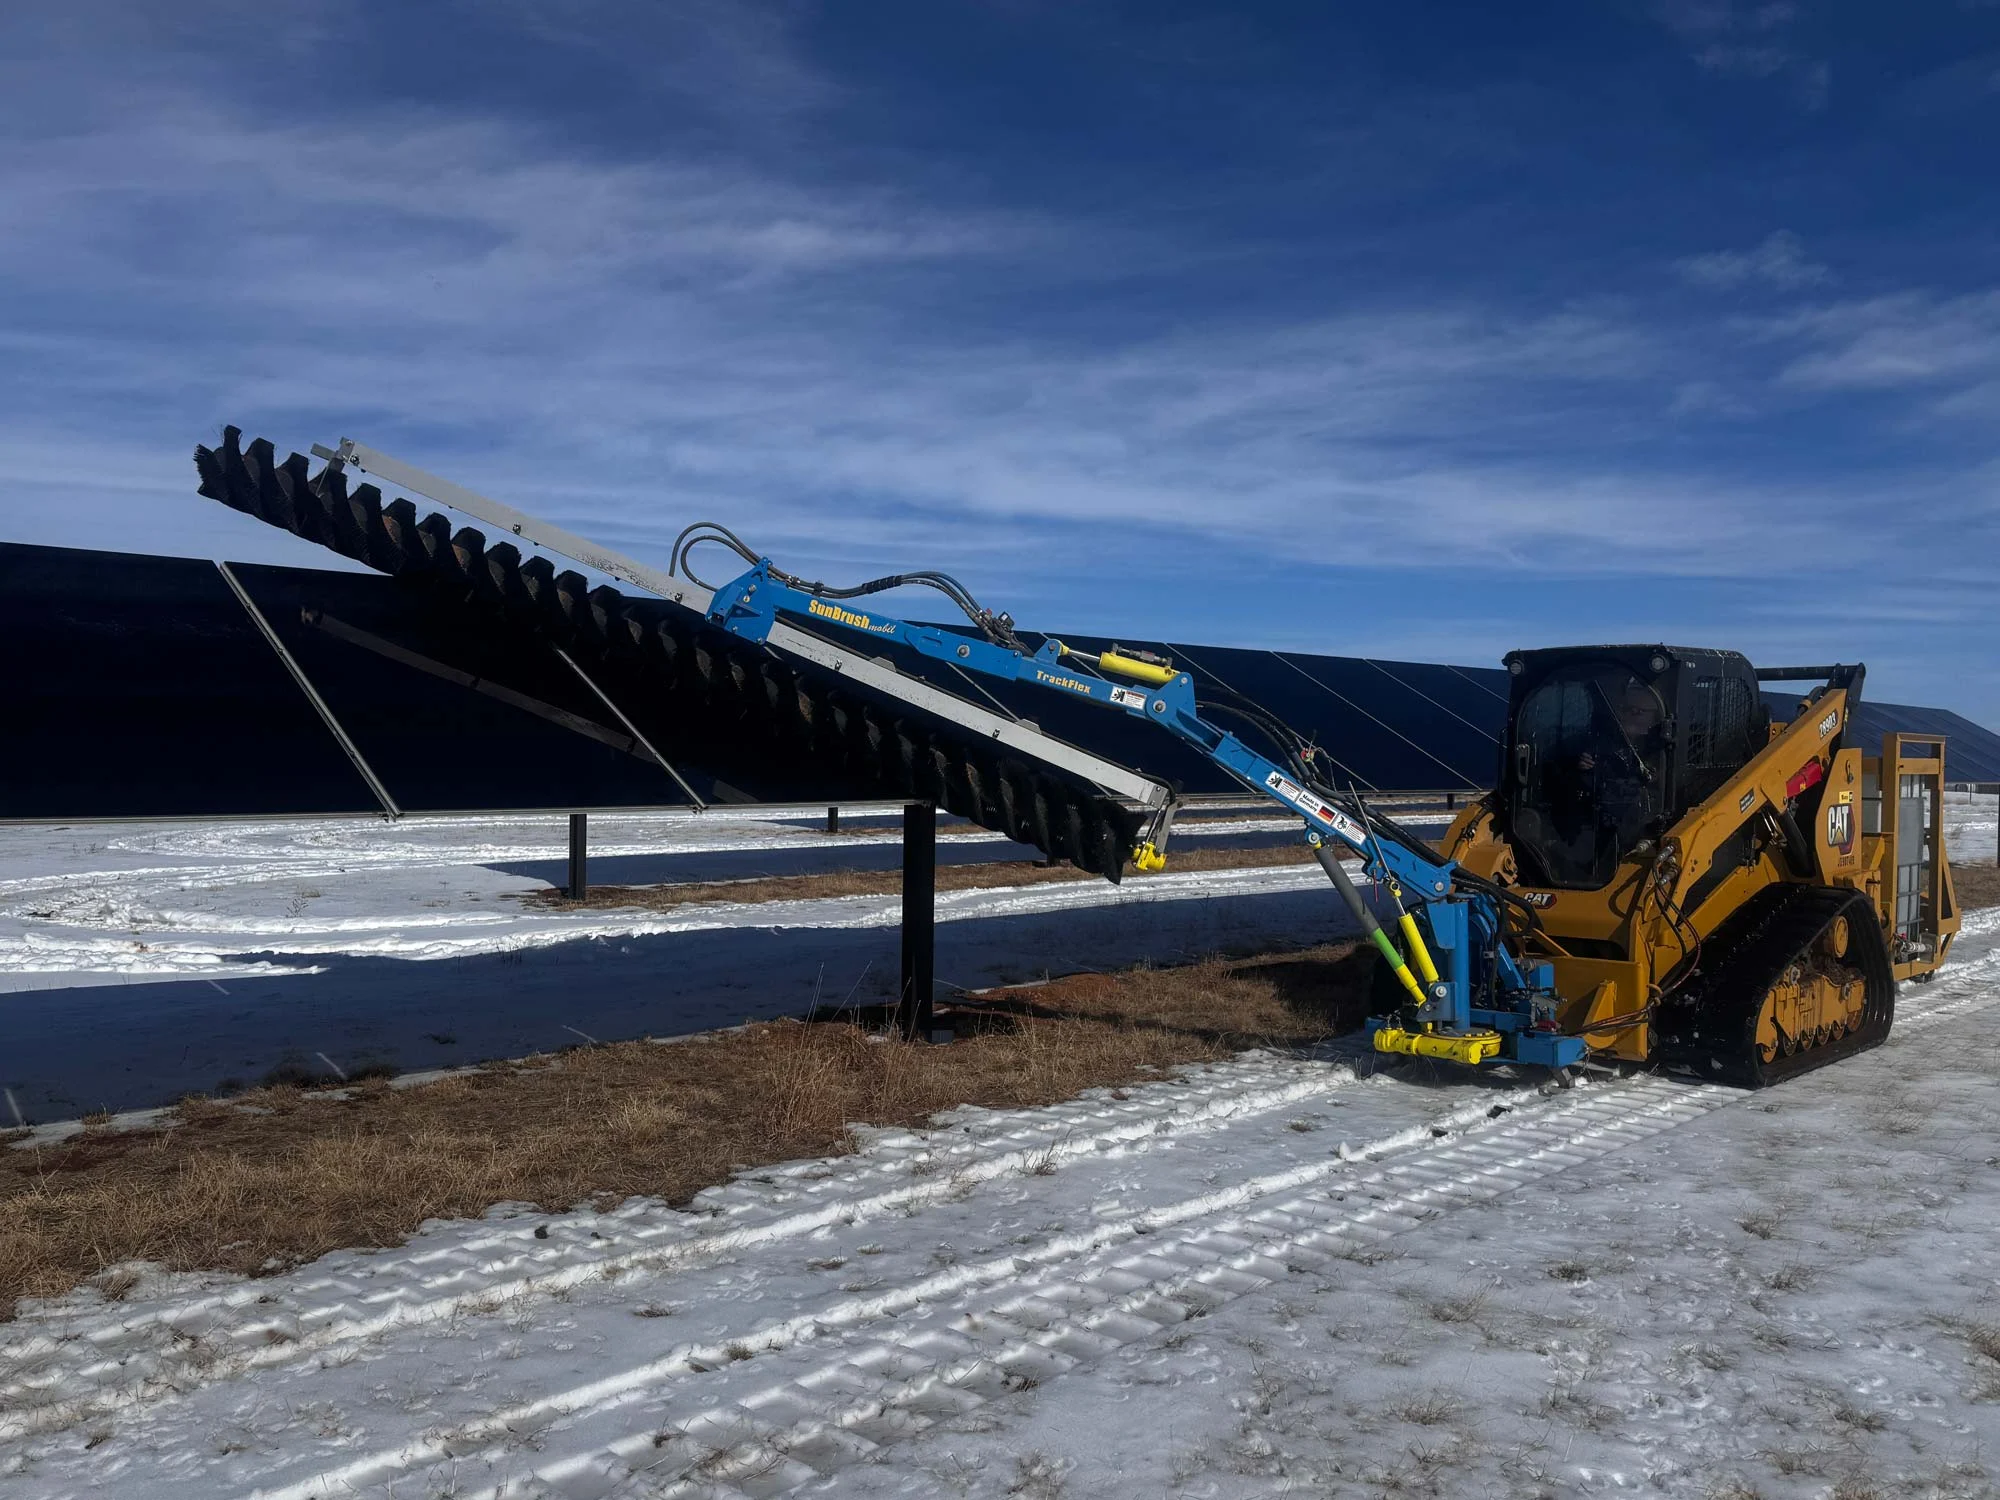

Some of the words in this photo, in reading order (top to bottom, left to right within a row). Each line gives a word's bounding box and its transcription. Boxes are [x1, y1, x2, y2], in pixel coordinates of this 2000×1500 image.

[808, 599, 870, 630] SunBrush
[868, 623, 897, 634] mobil
[1036, 669, 1092, 695] TrackFlex
[1298, 797, 1318, 812] Germany
[1302, 793, 1315, 805] Made
[1828, 805, 1849, 846] CAT
[1524, 892, 1552, 906] CAT
